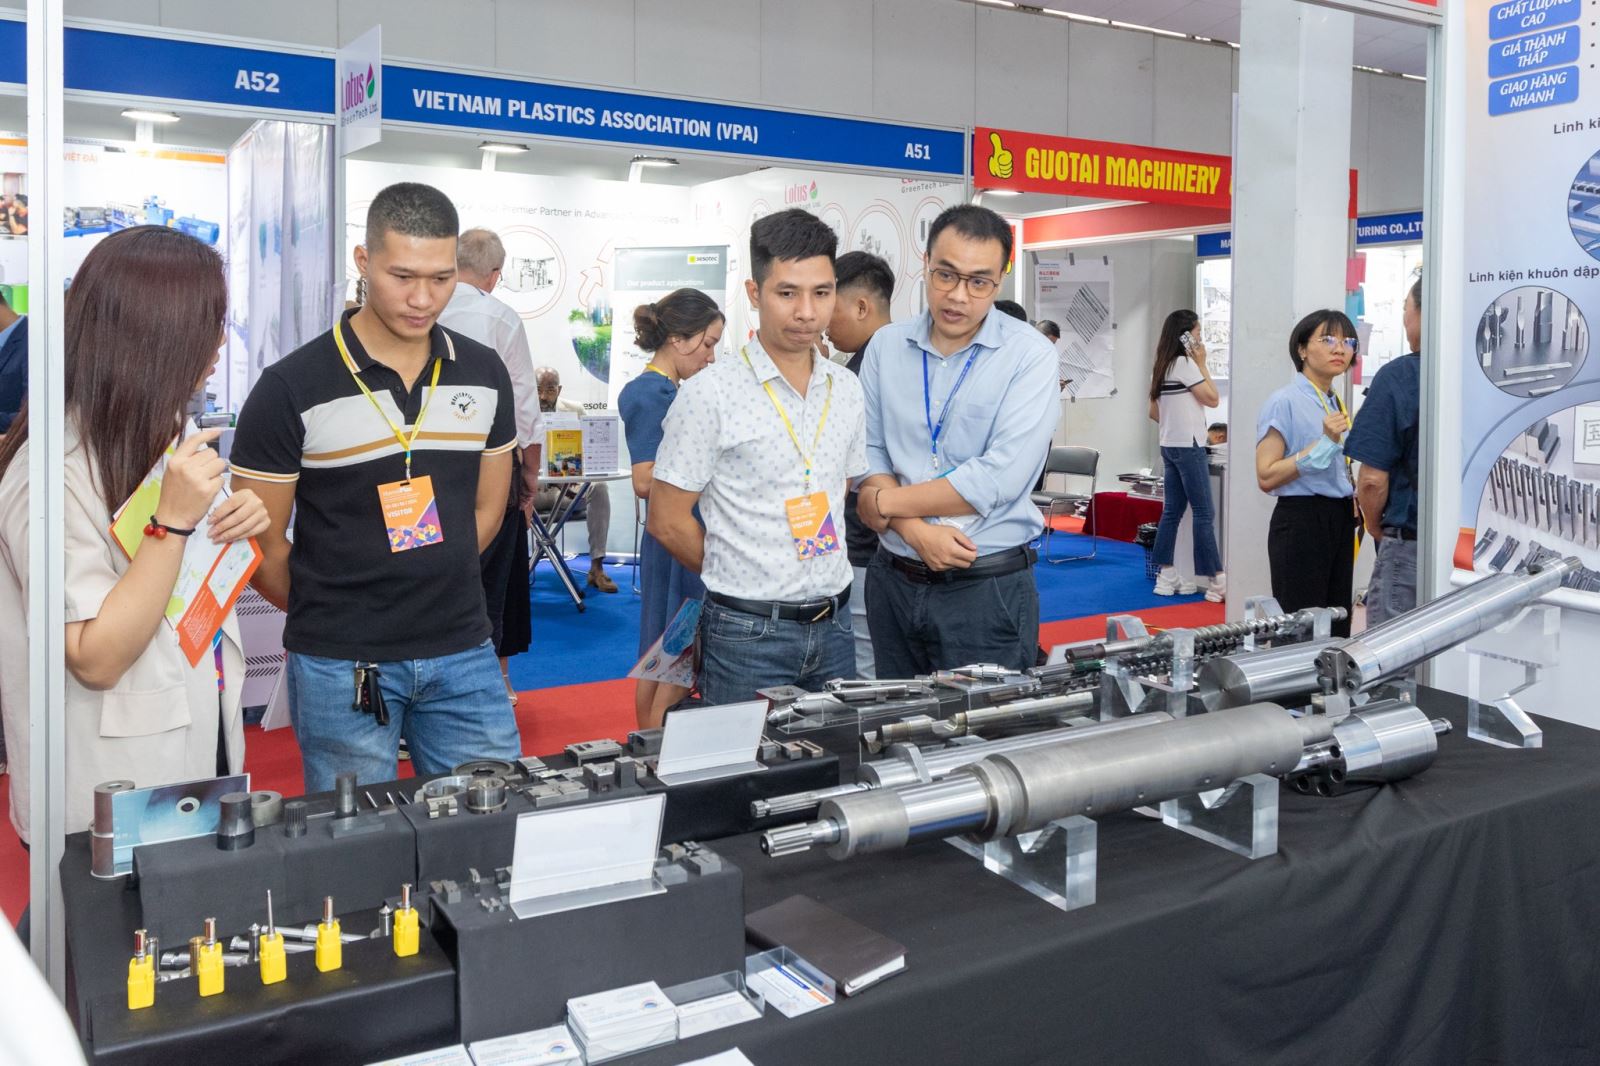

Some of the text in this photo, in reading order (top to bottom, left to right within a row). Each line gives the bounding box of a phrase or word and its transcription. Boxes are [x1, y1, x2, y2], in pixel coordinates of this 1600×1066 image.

[1521, 12, 1546, 27] CAO
[1501, 31, 1567, 57] GIÁ THÀNH
[1518, 47, 1548, 67] THẤP
[234, 69, 280, 93] A52
[1500, 71, 1568, 95] GIAO HÀNG
[341, 71, 364, 112] Lotus
[1510, 87, 1556, 107] NHANH
[412, 88, 759, 144] VIETNAM PLASTICS ASSOCIATION (VPA)
[1553, 121, 1584, 134] Linh
[904, 142, 931, 160] A51
[1025, 147, 1099, 185] GUOTAI
[1105, 155, 1221, 195] MACHINERY
[784, 184, 807, 204] Lotus
[540, 206, 571, 217] Partner
[574, 207, 582, 217] in
[1356, 221, 1424, 237] URING CO.,LT
[1469, 265, 1600, 283] Linh kiện khuôn dập
[386, 507, 413, 519] VISITOR
